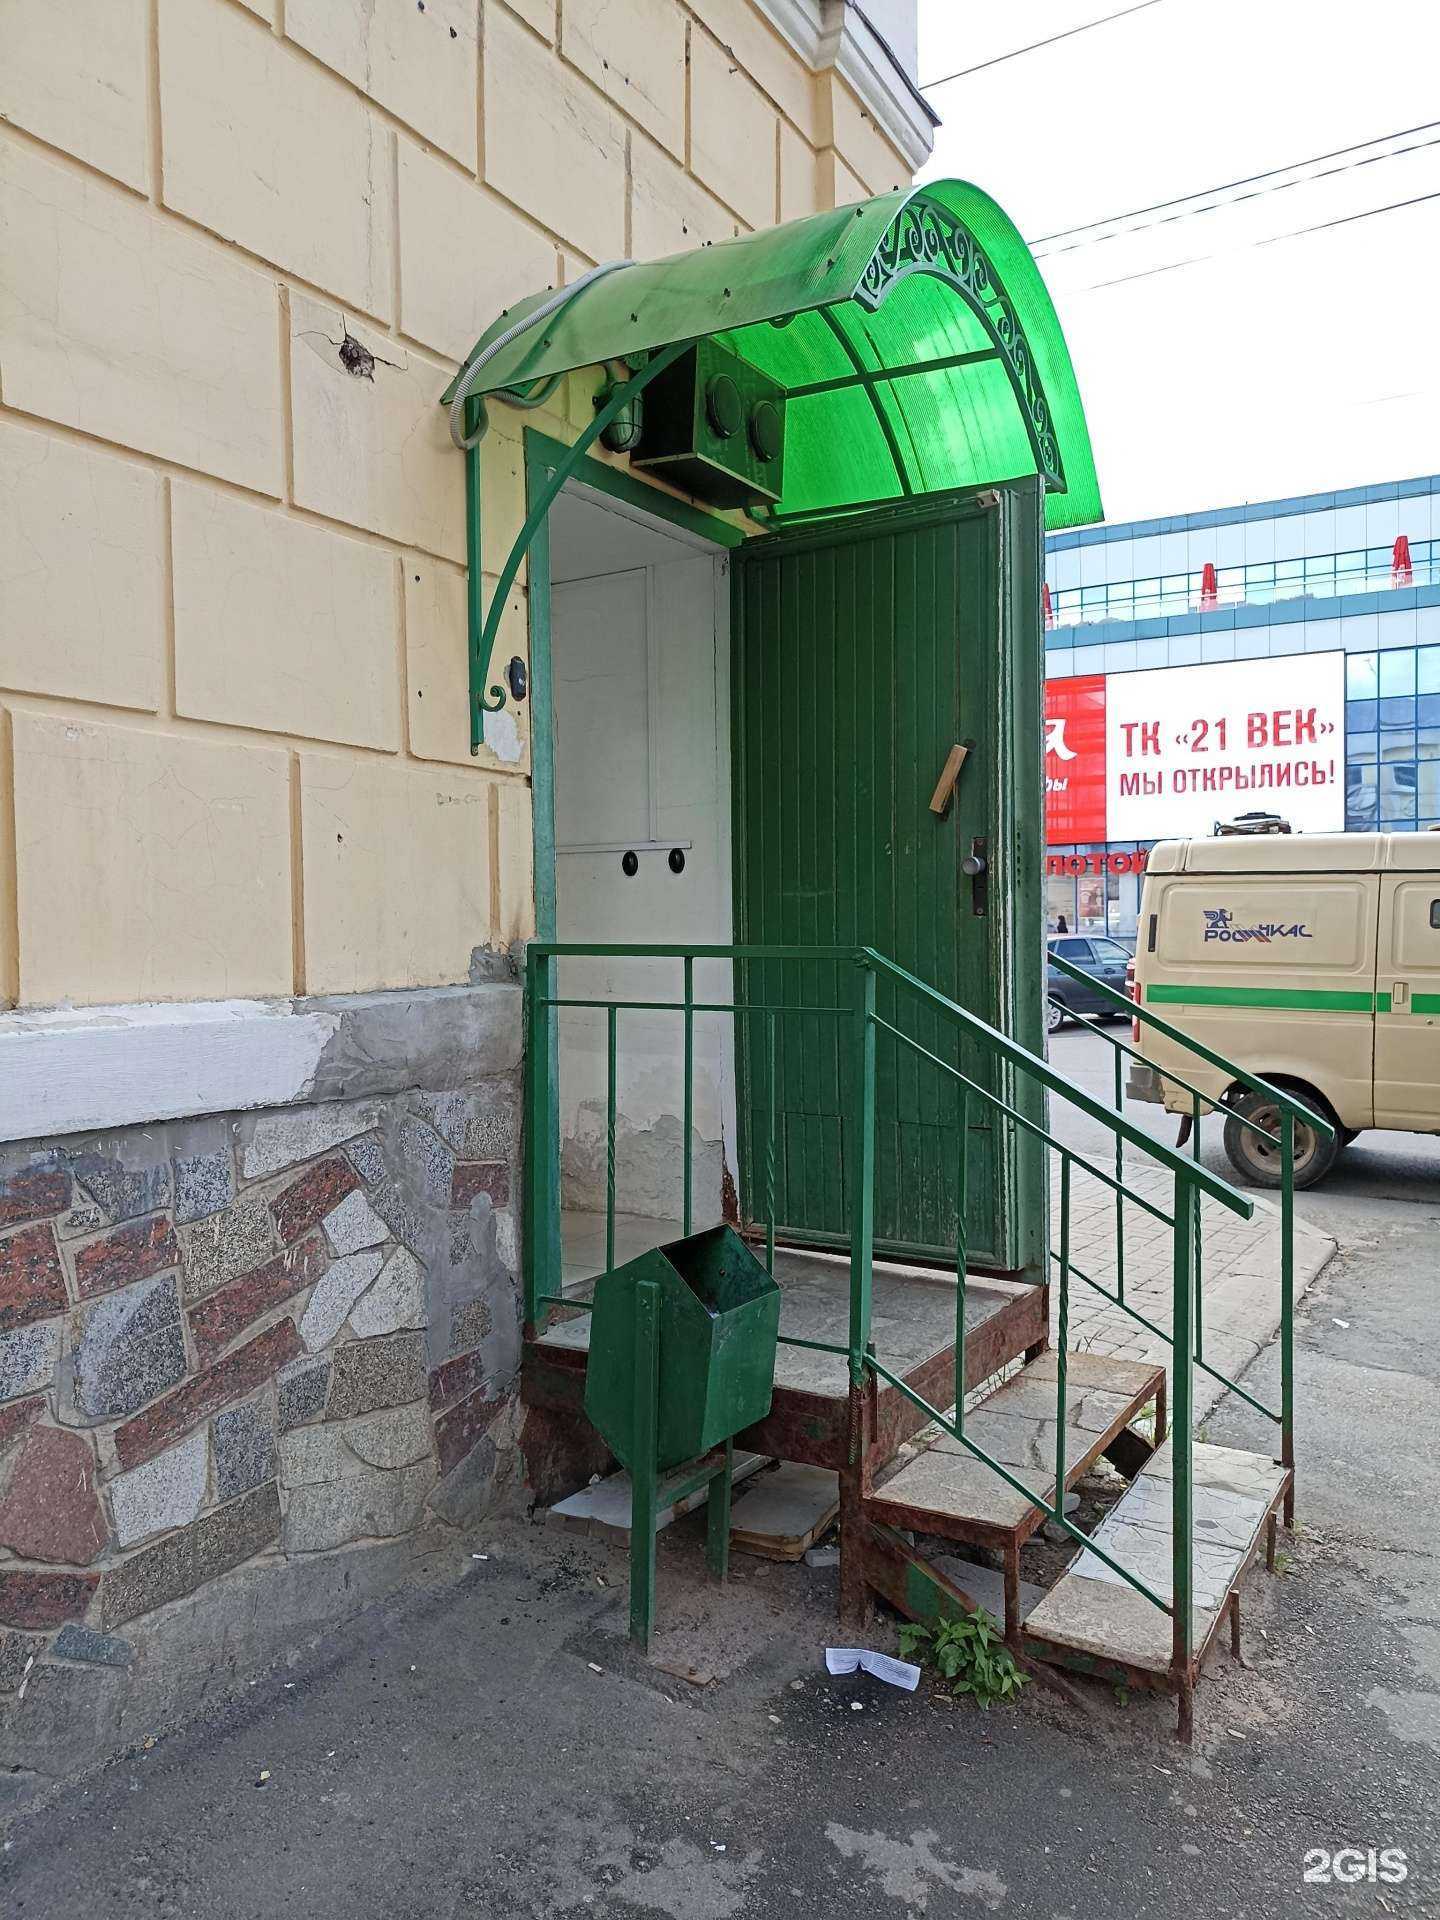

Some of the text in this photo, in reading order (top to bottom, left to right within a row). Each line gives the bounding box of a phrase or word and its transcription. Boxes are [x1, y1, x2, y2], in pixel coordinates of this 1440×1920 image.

[1120, 708, 1335, 757] ТК «21 ВЕК»
[1120, 760, 1334, 796] МЫ ОТКРЫЛИСЬ!
